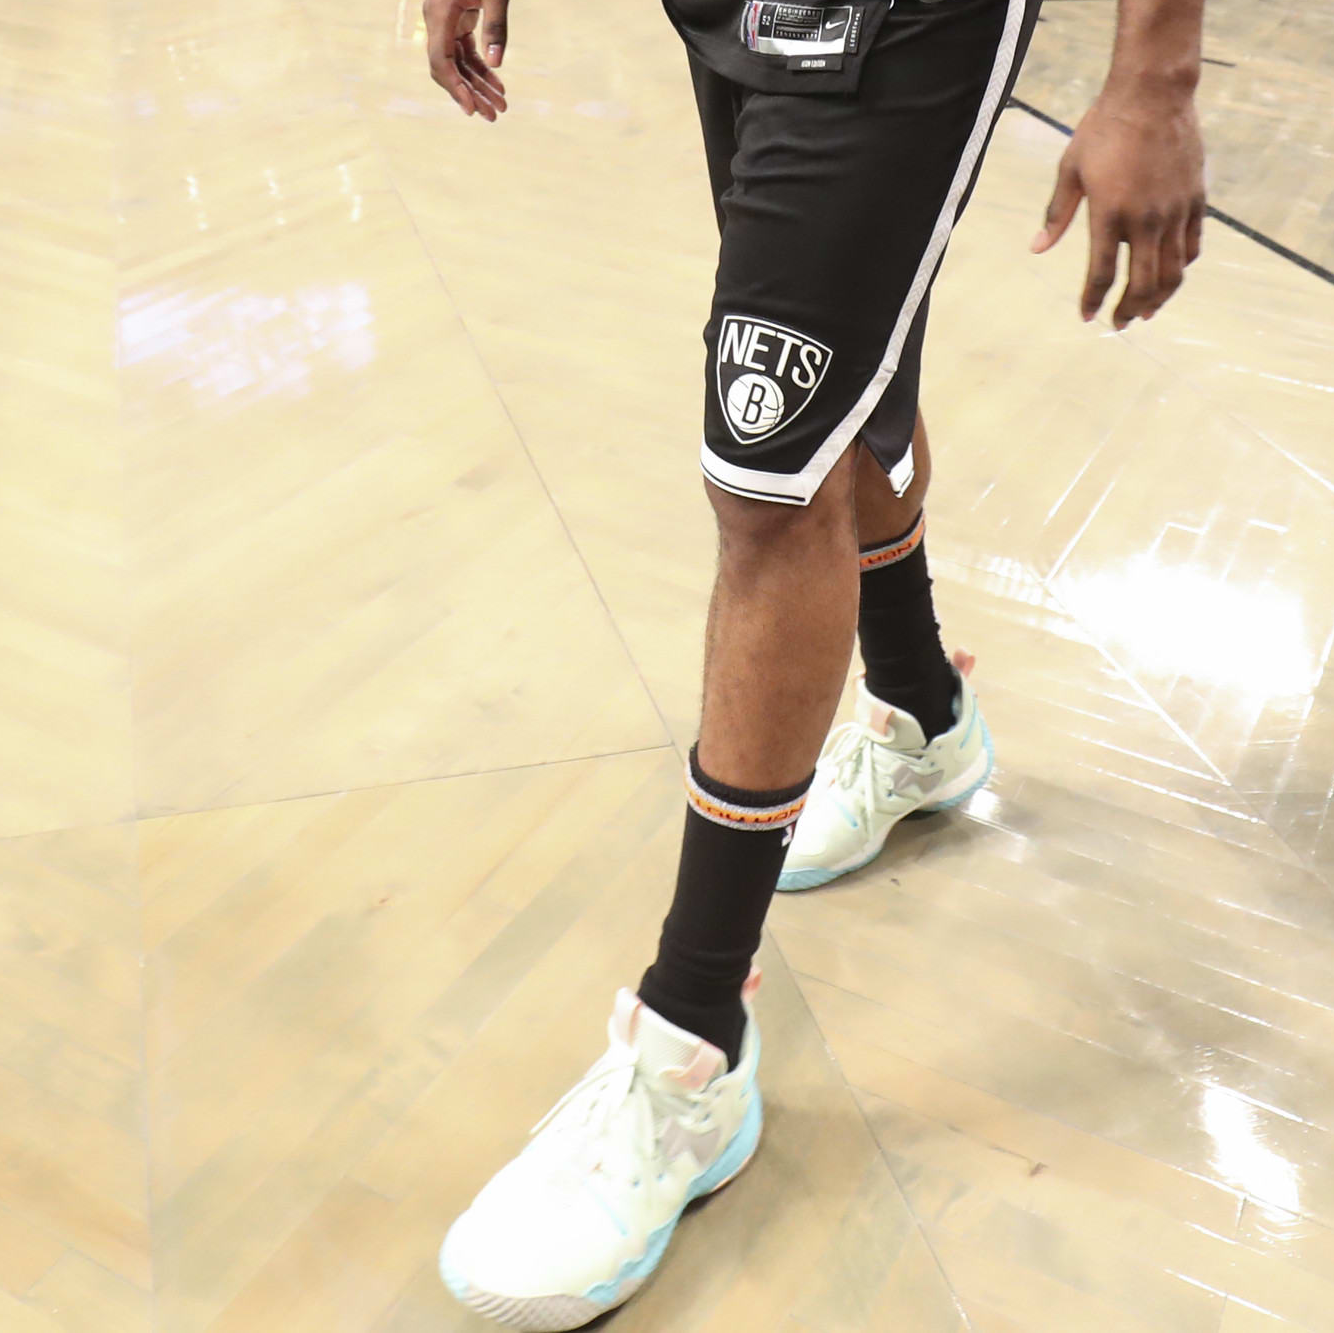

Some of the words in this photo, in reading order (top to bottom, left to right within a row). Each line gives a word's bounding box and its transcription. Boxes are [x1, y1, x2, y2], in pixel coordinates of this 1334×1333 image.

[762, 14, 772, 27] 52
[721, 322, 823, 389] NETS
[741, 382, 767, 425] B
